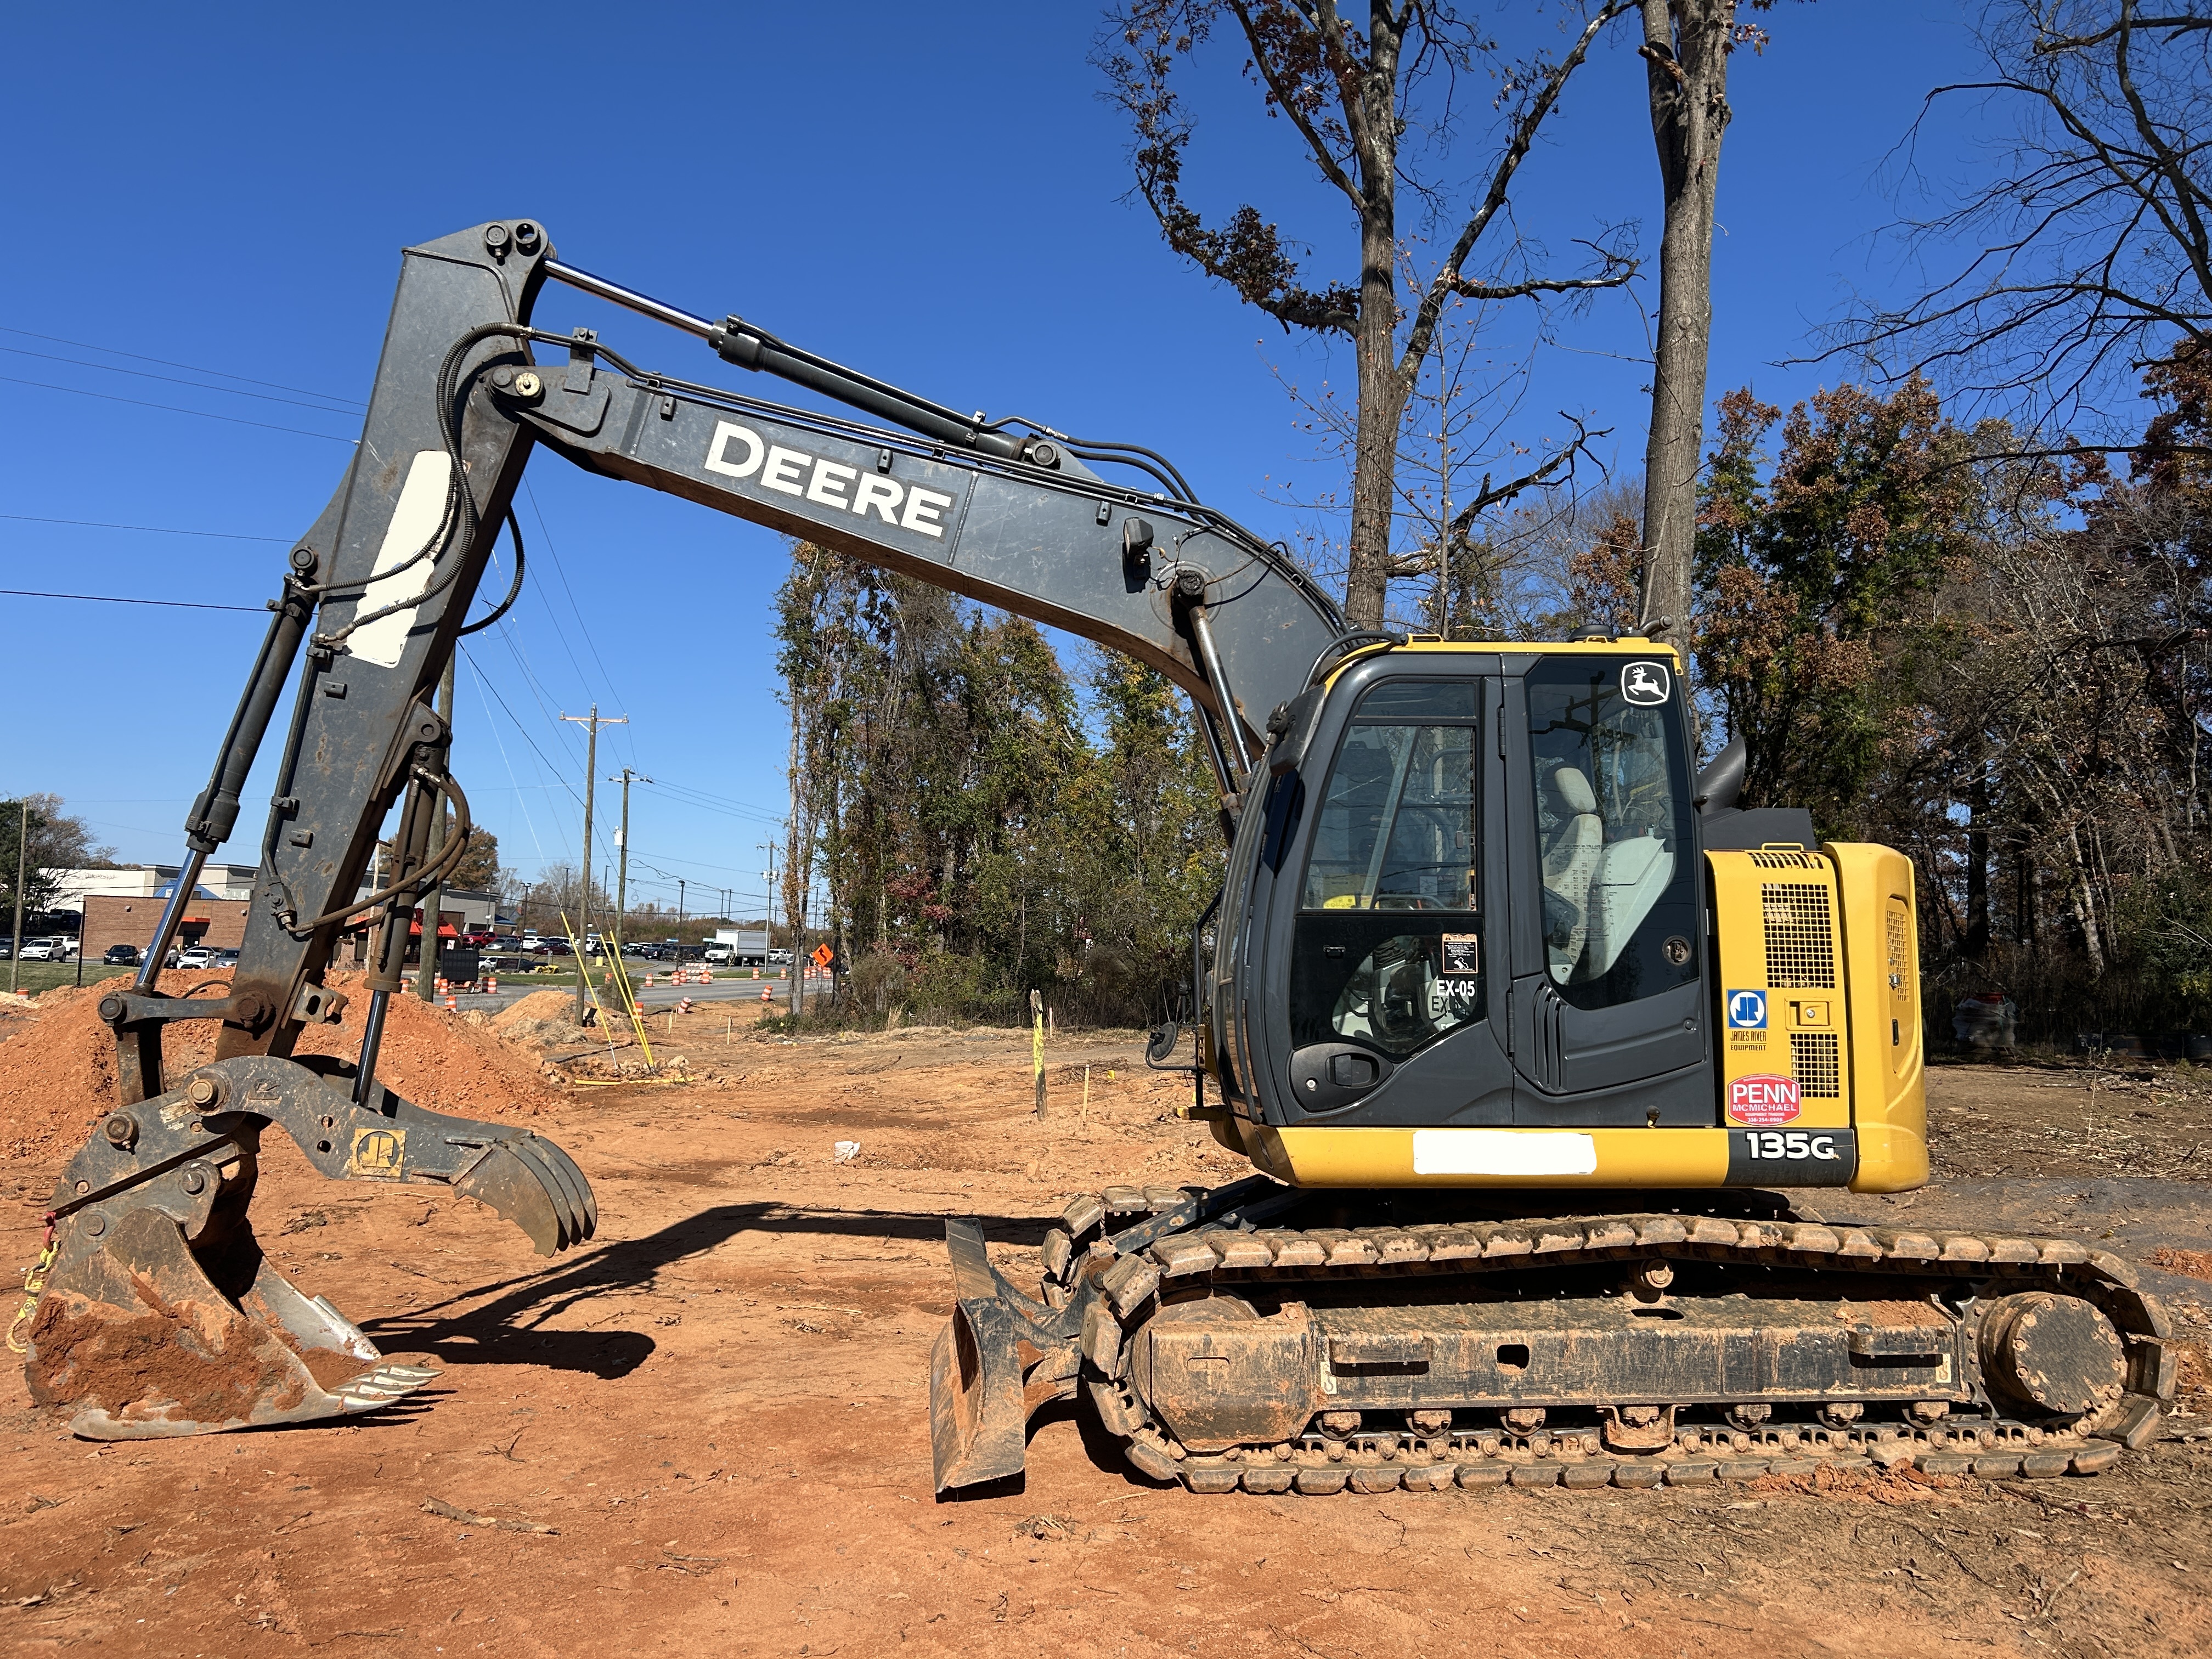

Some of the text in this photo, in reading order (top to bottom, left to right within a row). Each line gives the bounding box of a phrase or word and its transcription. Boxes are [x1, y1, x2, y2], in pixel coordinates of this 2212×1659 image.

[704, 420, 952, 538] DEERE
[1436, 980, 1475, 997] EX-05
[1730, 1031, 1767, 1042] JAMES RIVER
[1733, 1084, 1796, 1104] PENN
[1747, 1132, 1835, 1159] 135G
